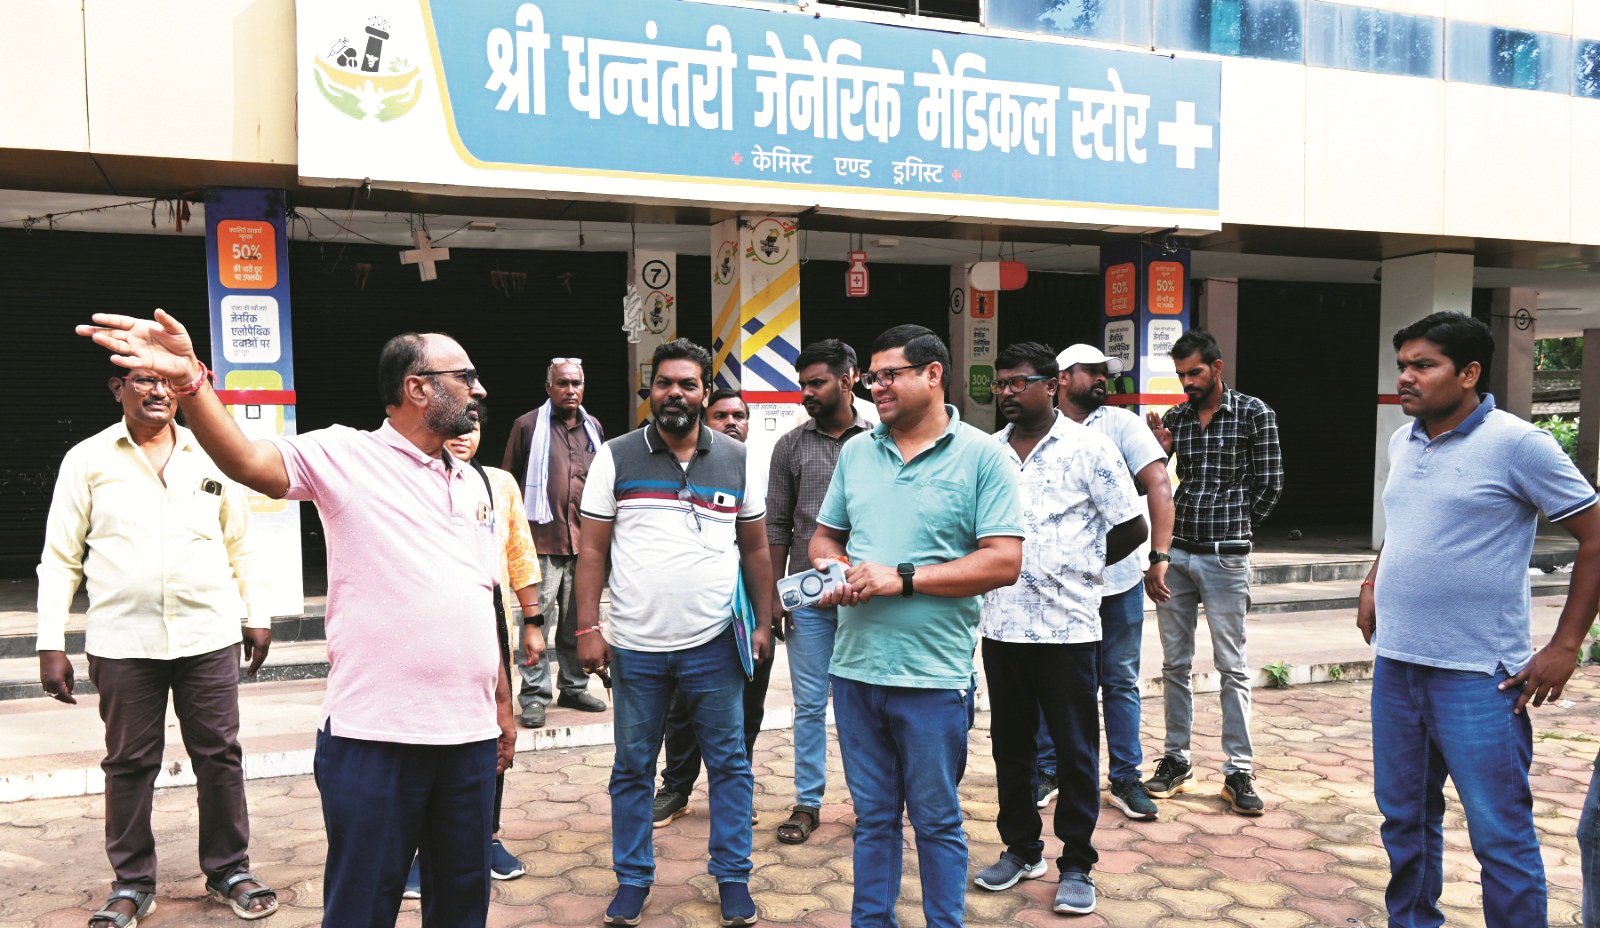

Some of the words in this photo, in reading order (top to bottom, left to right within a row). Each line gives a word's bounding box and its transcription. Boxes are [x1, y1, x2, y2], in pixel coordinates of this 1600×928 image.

[485, 3, 550, 115] श्री
[562, 20, 737, 131] धन्वंतरी
[747, 31, 905, 144] जेनेरिक
[914, 49, 1060, 156] मेडिकल
[1068, 67, 1151, 164] स्टोर
[751, 144, 813, 174] केमिस्ट
[833, 157, 872, 178] एण्ड
[892, 155, 944, 184] ड्रगिस्ट
[232, 243, 262, 260] 50%
[650, 268, 662, 284] 7
[1112, 281, 1128, 295] 50%
[1156, 279, 1175, 292] 50%
[954, 294, 960, 308] 6
[230, 312, 258, 323] जेनरिक
[1519, 313, 1527, 326] 5
[231, 324, 271, 337] एलोपैथिक
[260, 340, 271, 349] पर
